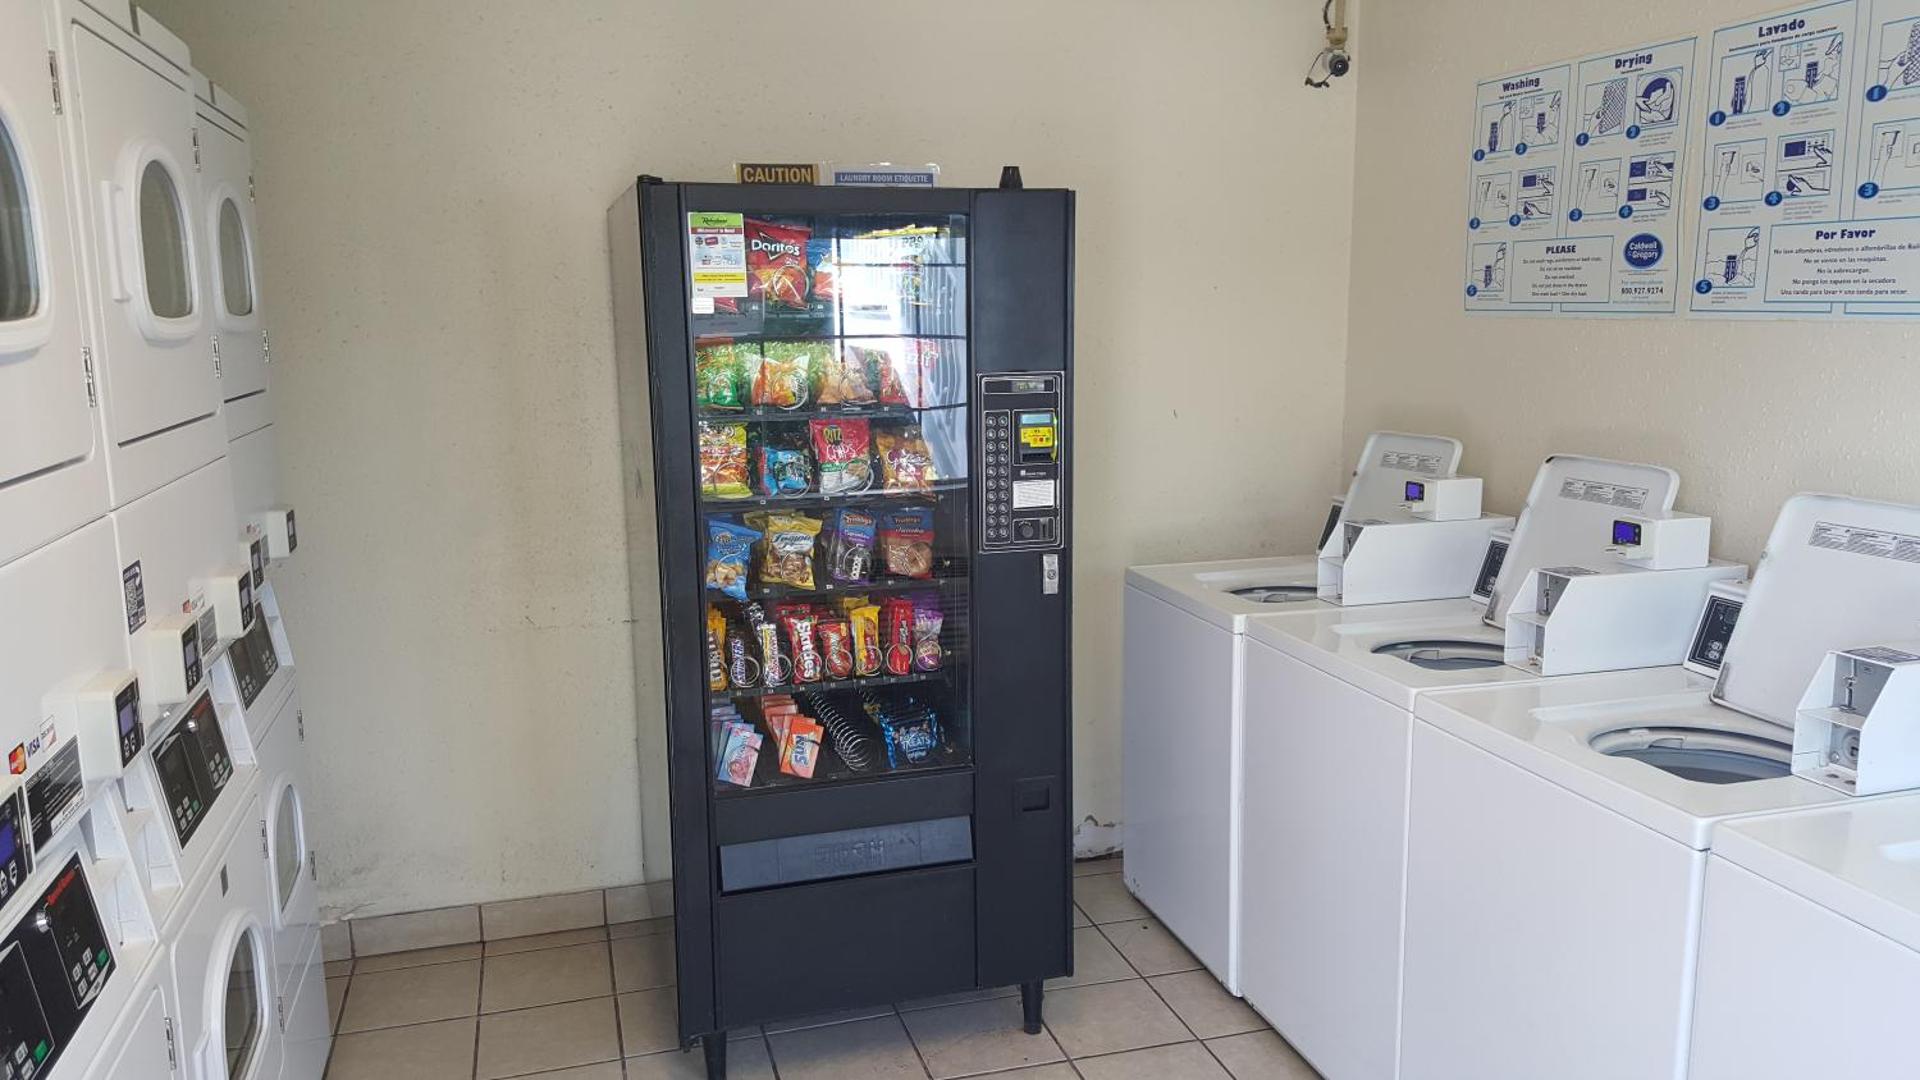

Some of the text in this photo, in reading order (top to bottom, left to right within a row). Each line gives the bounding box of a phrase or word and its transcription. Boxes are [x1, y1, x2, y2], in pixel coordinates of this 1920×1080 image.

[1758, 19, 1805, 38] Lavado
[1614, 53, 1653, 69] Drying
[1502, 77, 1540, 92] Washing
[743, 167, 813, 183] CAUTION
[840, 174, 929, 183] LAUNDRY ROOM ETIQUETTE
[1815, 229, 1876, 240] Por Favor
[751, 239, 800, 256] Doritos
[1545, 245, 1576, 254] PLEASE
[1629, 241, 1657, 250] Caldwell
[1632, 250, 1659, 260] Gregory
[1621, 286, 1664, 295] 800.927.9274
[822, 427, 843, 441] RITZ
[826, 444, 856, 461] CHIPS
[797, 620, 815, 678] Skittles
[26, 736, 40, 757] VISA
